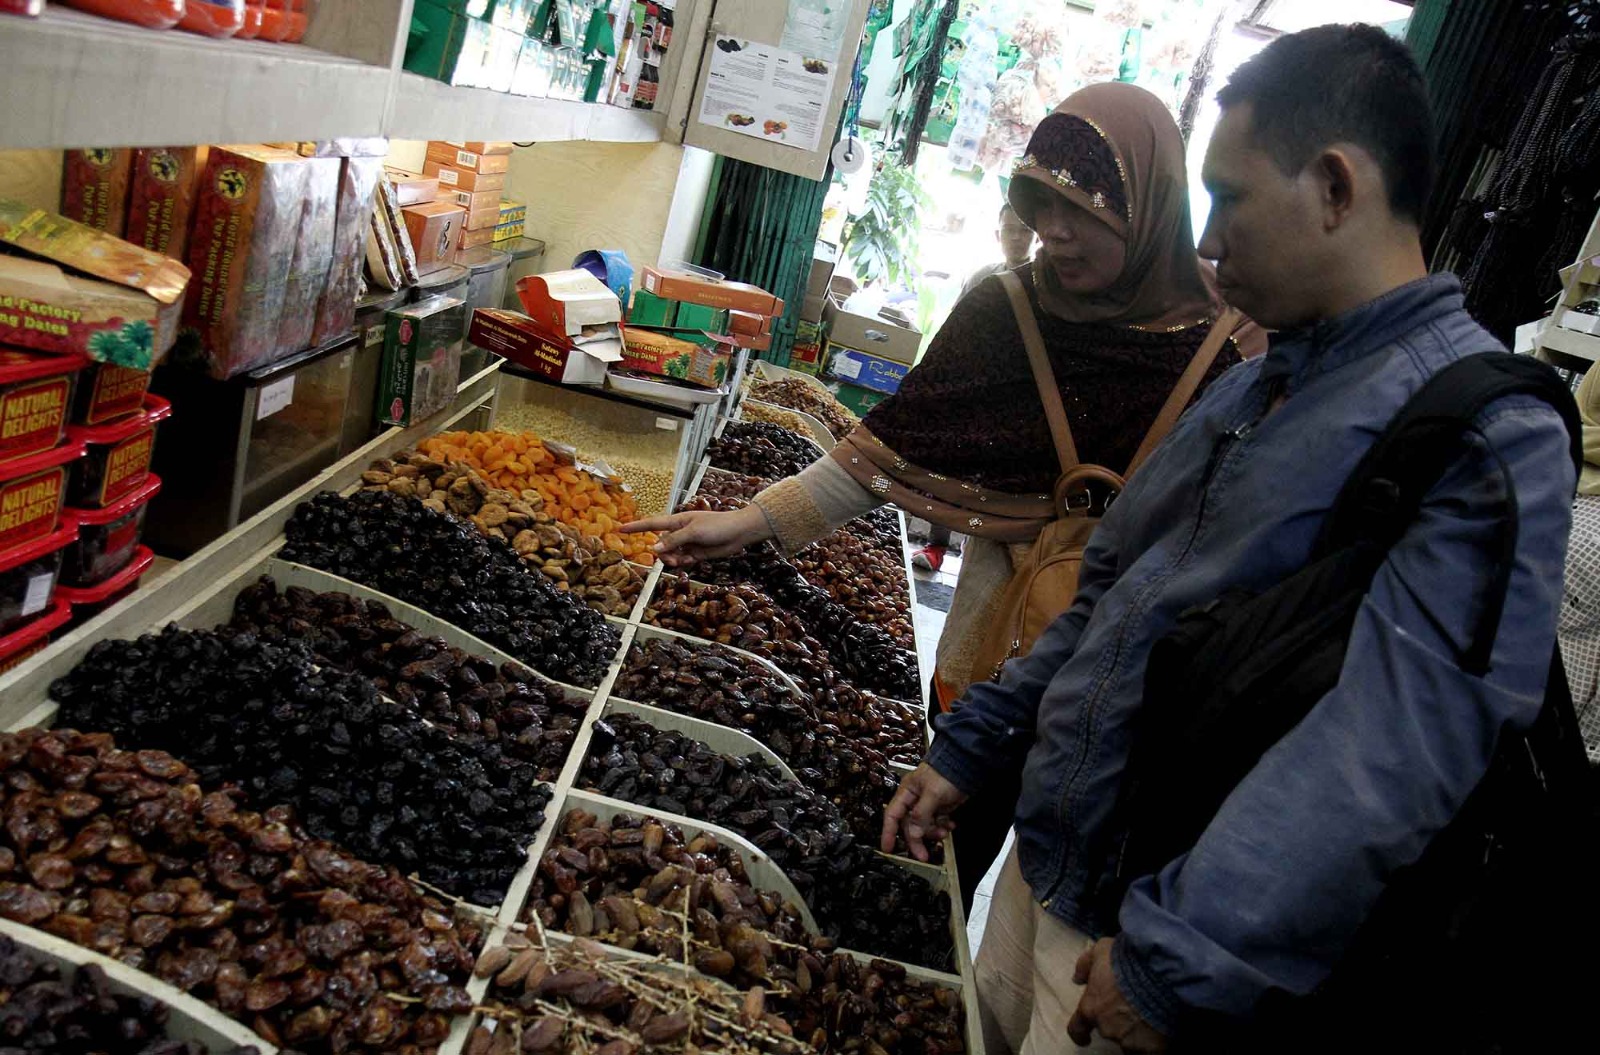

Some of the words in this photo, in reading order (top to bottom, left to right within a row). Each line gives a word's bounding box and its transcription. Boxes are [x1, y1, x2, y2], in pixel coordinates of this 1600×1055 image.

[226, 215, 241, 248] World
[20, 298, 81, 321] Factory
[25, 316, 69, 335] Dates
[6, 388, 62, 416] NATURAL
[2, 412, 59, 438] DELIGHTS
[3, 479, 57, 513] NATURAL
[0, 503, 56, 531] DELIGHTS
